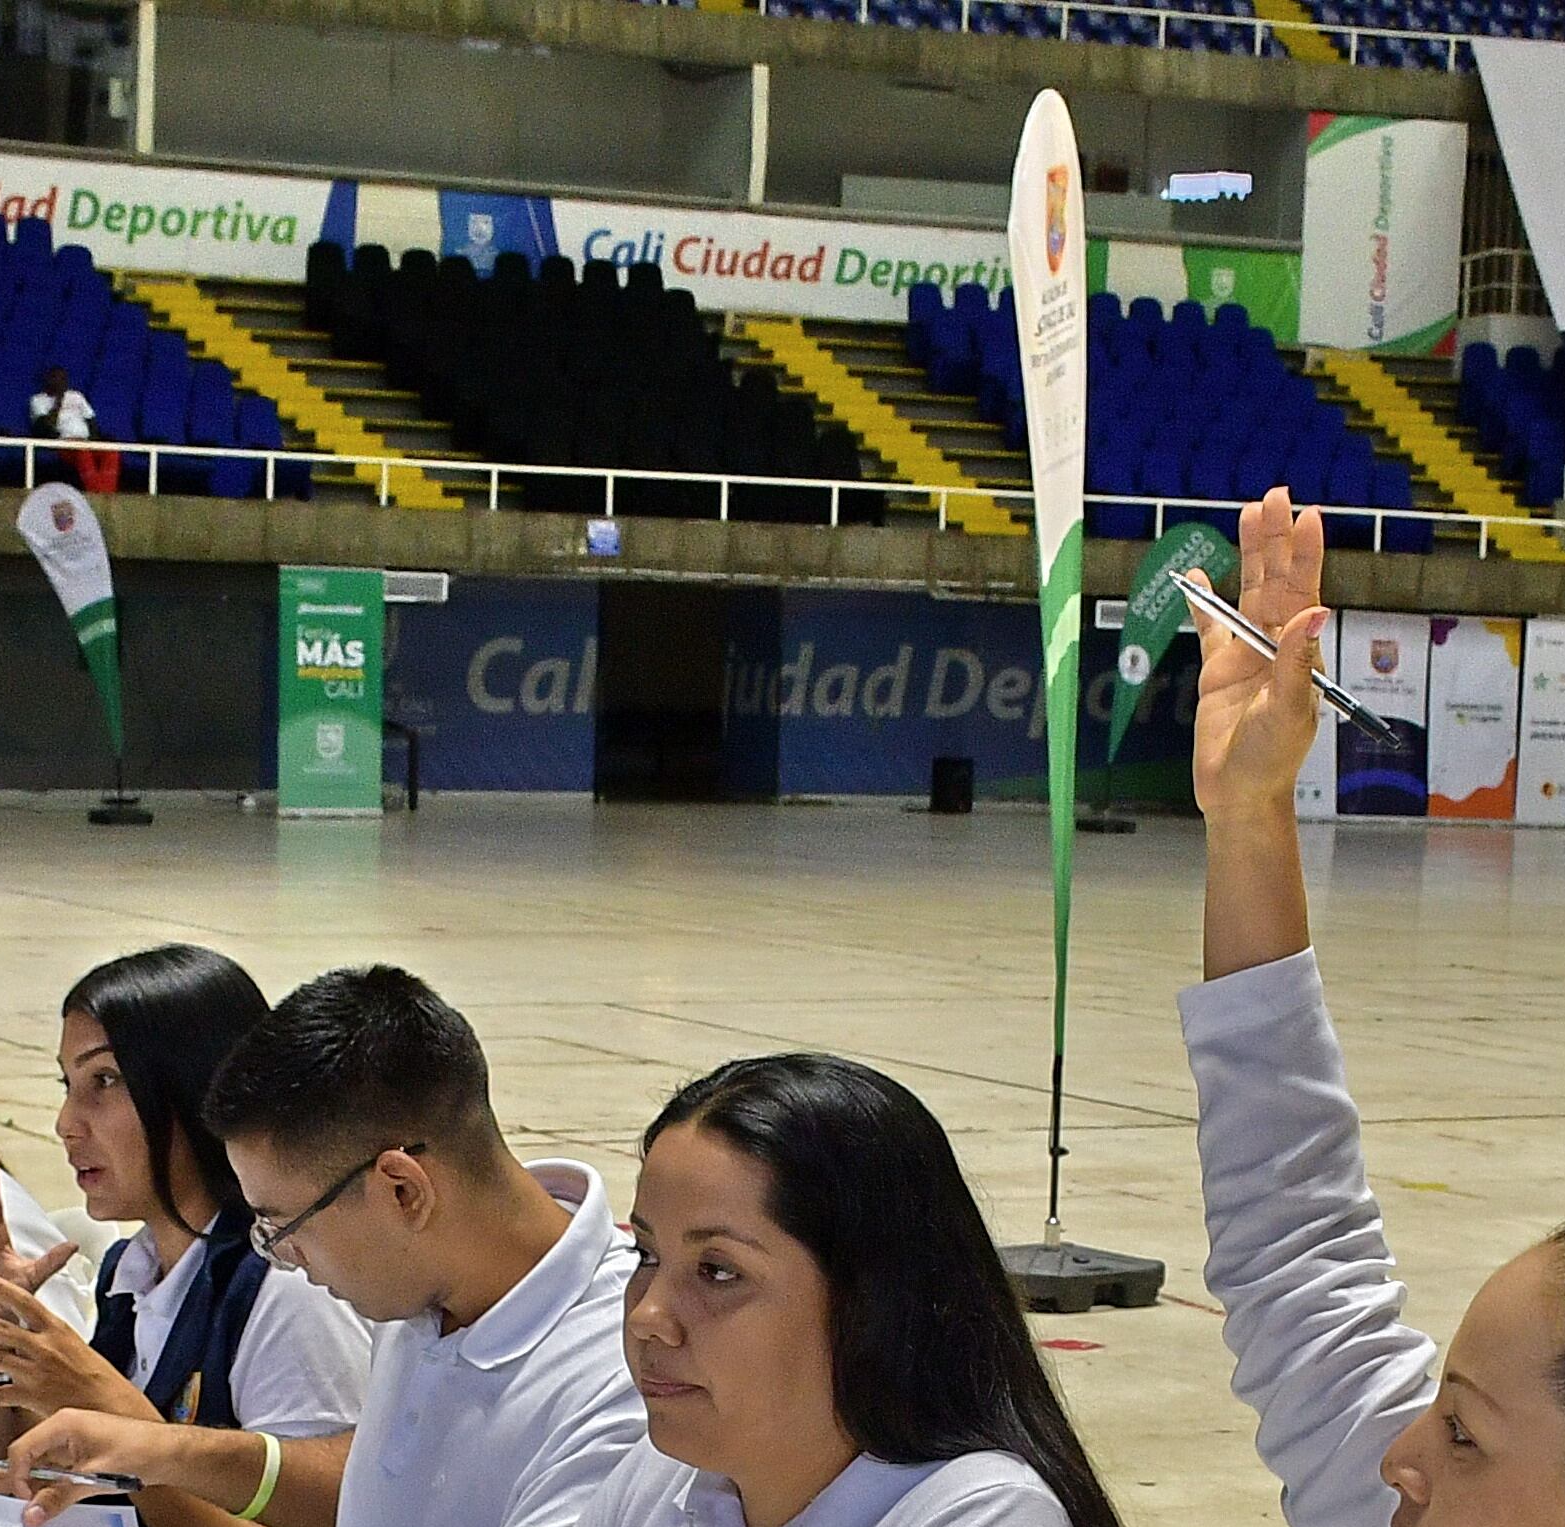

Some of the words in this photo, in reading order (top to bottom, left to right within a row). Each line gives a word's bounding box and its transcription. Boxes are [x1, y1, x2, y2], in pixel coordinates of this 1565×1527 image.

[67, 189, 297, 246] Deportiva
[583, 229, 665, 268] Cali
[672, 236, 825, 283] Ciudad
[835, 247, 1014, 293] Deporti
[1142, 541, 1216, 622] ECONICO
[297, 632, 364, 667] MÁS
[466, 636, 600, 715] Cal
